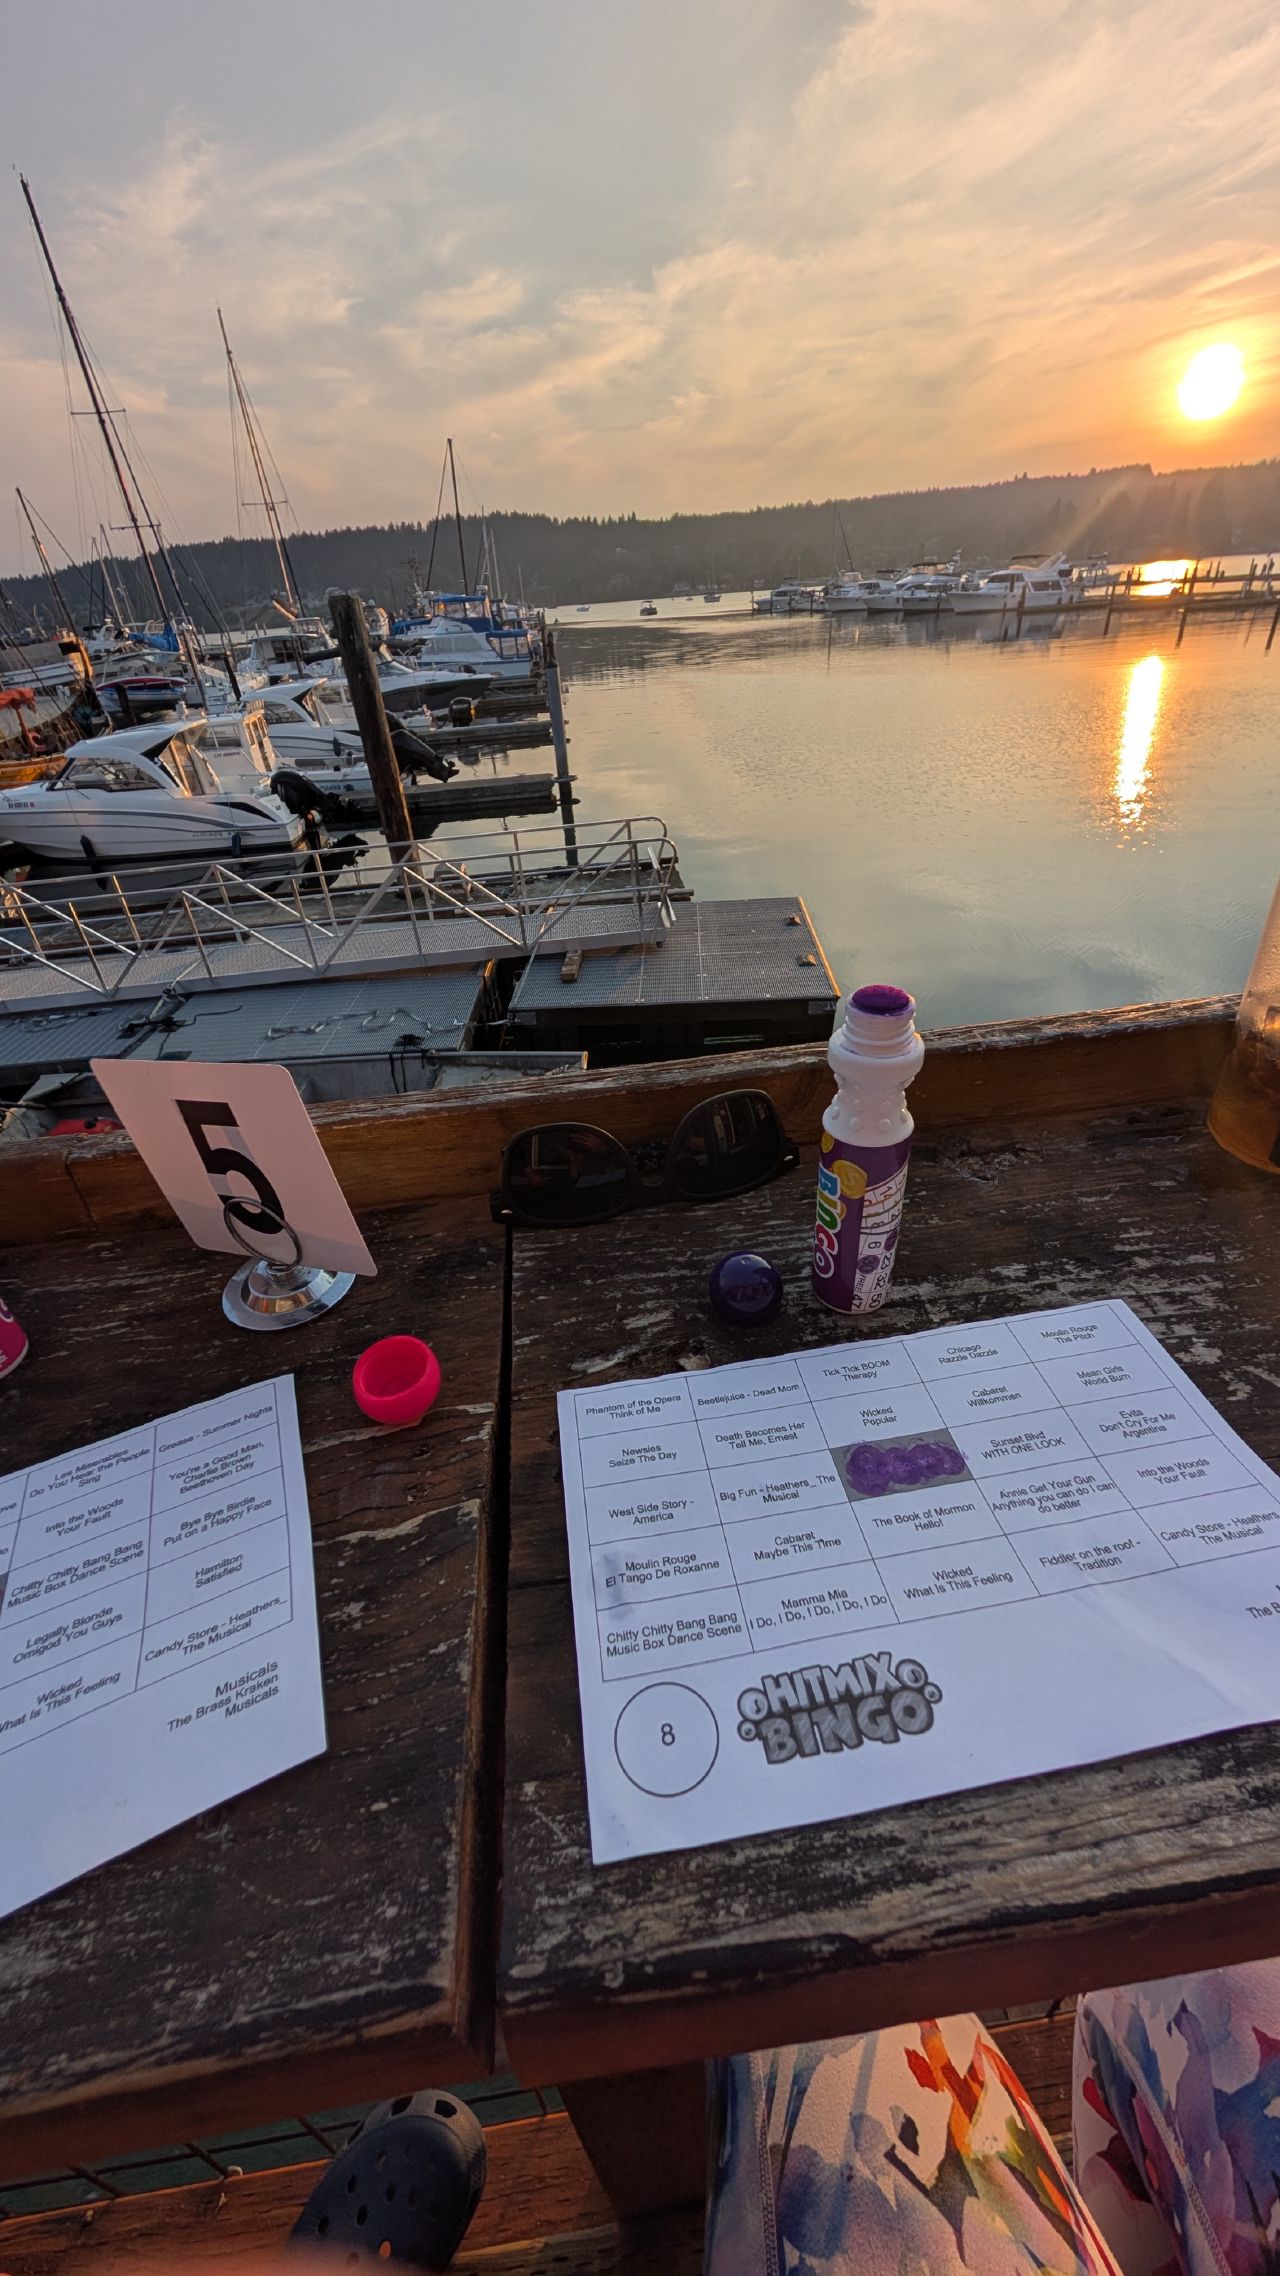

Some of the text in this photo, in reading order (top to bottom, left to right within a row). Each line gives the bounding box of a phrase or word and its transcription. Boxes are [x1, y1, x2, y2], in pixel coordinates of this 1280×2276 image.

[174, 1099, 285, 1235] 5
[813, 1163, 843, 1279] BINGO
[855, 1274, 867, 1292] FREE
[938, 1349, 998, 1365] Razzle Dazzle
[946, 1344, 982, 1355] Chicago
[822, 1359, 890, 1376] Tick Tick BOOM
[841, 1371, 877, 1381] Therapy
[1076, 1366, 1124, 1379] Mean Girls
[697, 1384, 800, 1406] Beetlejuice Dead Mom
[966, 1393, 1022, 1407] Willkommen
[972, 1386, 1008, 1398] Cabaret
[586, 1404, 625, 1415] Phantom
[627, 1400, 636, 1409] of
[654, 1395, 681, 1405] Opera
[609, 1406, 661, 1419] Think of Me
[859, 1406, 893, 1418] Wicked
[1118, 1409, 1144, 1419] Evita
[862, 1415, 897, 1427] Popular
[1124, 1419, 1142, 1428] Cry
[1142, 1416, 1159, 1425] For
[1158, 1413, 1176, 1421] Me
[715, 1422, 805, 1442] Death Becomes Her
[728, 1440, 747, 1449] Tell
[767, 1432, 798, 1443] Ernest
[990, 1431, 1046, 1448] Sunset Blvd
[1123, 1425, 1167, 1438] Argentina
[622, 1445, 661, 1457] Newsies
[981, 1437, 1066, 1459] WITH ONE LOOK
[609, 1452, 677, 1468] Seize The Day
[1136, 1458, 1210, 1478] Into the Woods
[1000, 1475, 1096, 1499] Annie Get Your Gun
[1154, 1469, 1208, 1485] Your Fault
[719, 1492, 736, 1502] Big
[738, 1488, 758, 1498] Fun
[816, 1475, 836, 1484] The
[762, 1490, 800, 1503] Musical
[992, 1482, 1116, 1512] Anything you can do I can
[45, 1498, 124, 1533] Into the Woods
[180, 1496, 255, 1531] Bye Bye Birdie
[608, 1500, 687, 1519] West Side Story
[872, 1503, 976, 1528] The Book of Mormon
[1038, 1500, 1081, 1513] do better
[57, 1510, 111, 1537] Your Fault
[633, 1512, 674, 1525] America
[914, 1518, 944, 1532] Hello!
[774, 1531, 816, 1546] Cabaret
[1160, 1528, 1196, 1541] Candy
[1195, 1523, 1225, 1534] Store
[1198, 1524, 1265, 1545] The Musical
[754, 1539, 842, 1560] Maybe This Time
[1039, 1539, 1135, 1567] Fiddler on the roof
[195, 1554, 243, 1579] Hamilton
[625, 1554, 696, 1572] Moulin Rouge
[1073, 1557, 1122, 1571] Tradition
[195, 1562, 242, 1588] Satisfied
[605, 1561, 720, 1588] El Tango De Roxanne
[932, 1566, 973, 1581] Wicked
[903, 1572, 1014, 1599] What Is This Feeling
[781, 1589, 848, 1610] Mamma Mia
[1245, 1607, 1273, 1619] The
[26, 1607, 113, 1649] Legally Blonde
[65, 1628, 88, 1642] You
[92, 1614, 123, 1631] Guys
[182, 1618, 252, 1656] The Musical
[607, 1612, 738, 1644] Chitty Chitty Bang Bang
[144, 1639, 184, 1661] Candy
[187, 1625, 219, 1643] Store
[606, 1624, 742, 1657] Music Box Dance Scene
[215, 1662, 278, 1698] Musicals
[761, 1652, 902, 1714] HITMIX
[37, 1676, 83, 1705] Wicked
[167, 1674, 278, 1732] The Brass Kraken
[225, 1686, 279, 1718] Musicals
[660, 1723, 676, 1746] 8
[758, 1688, 935, 1765] BINGO
